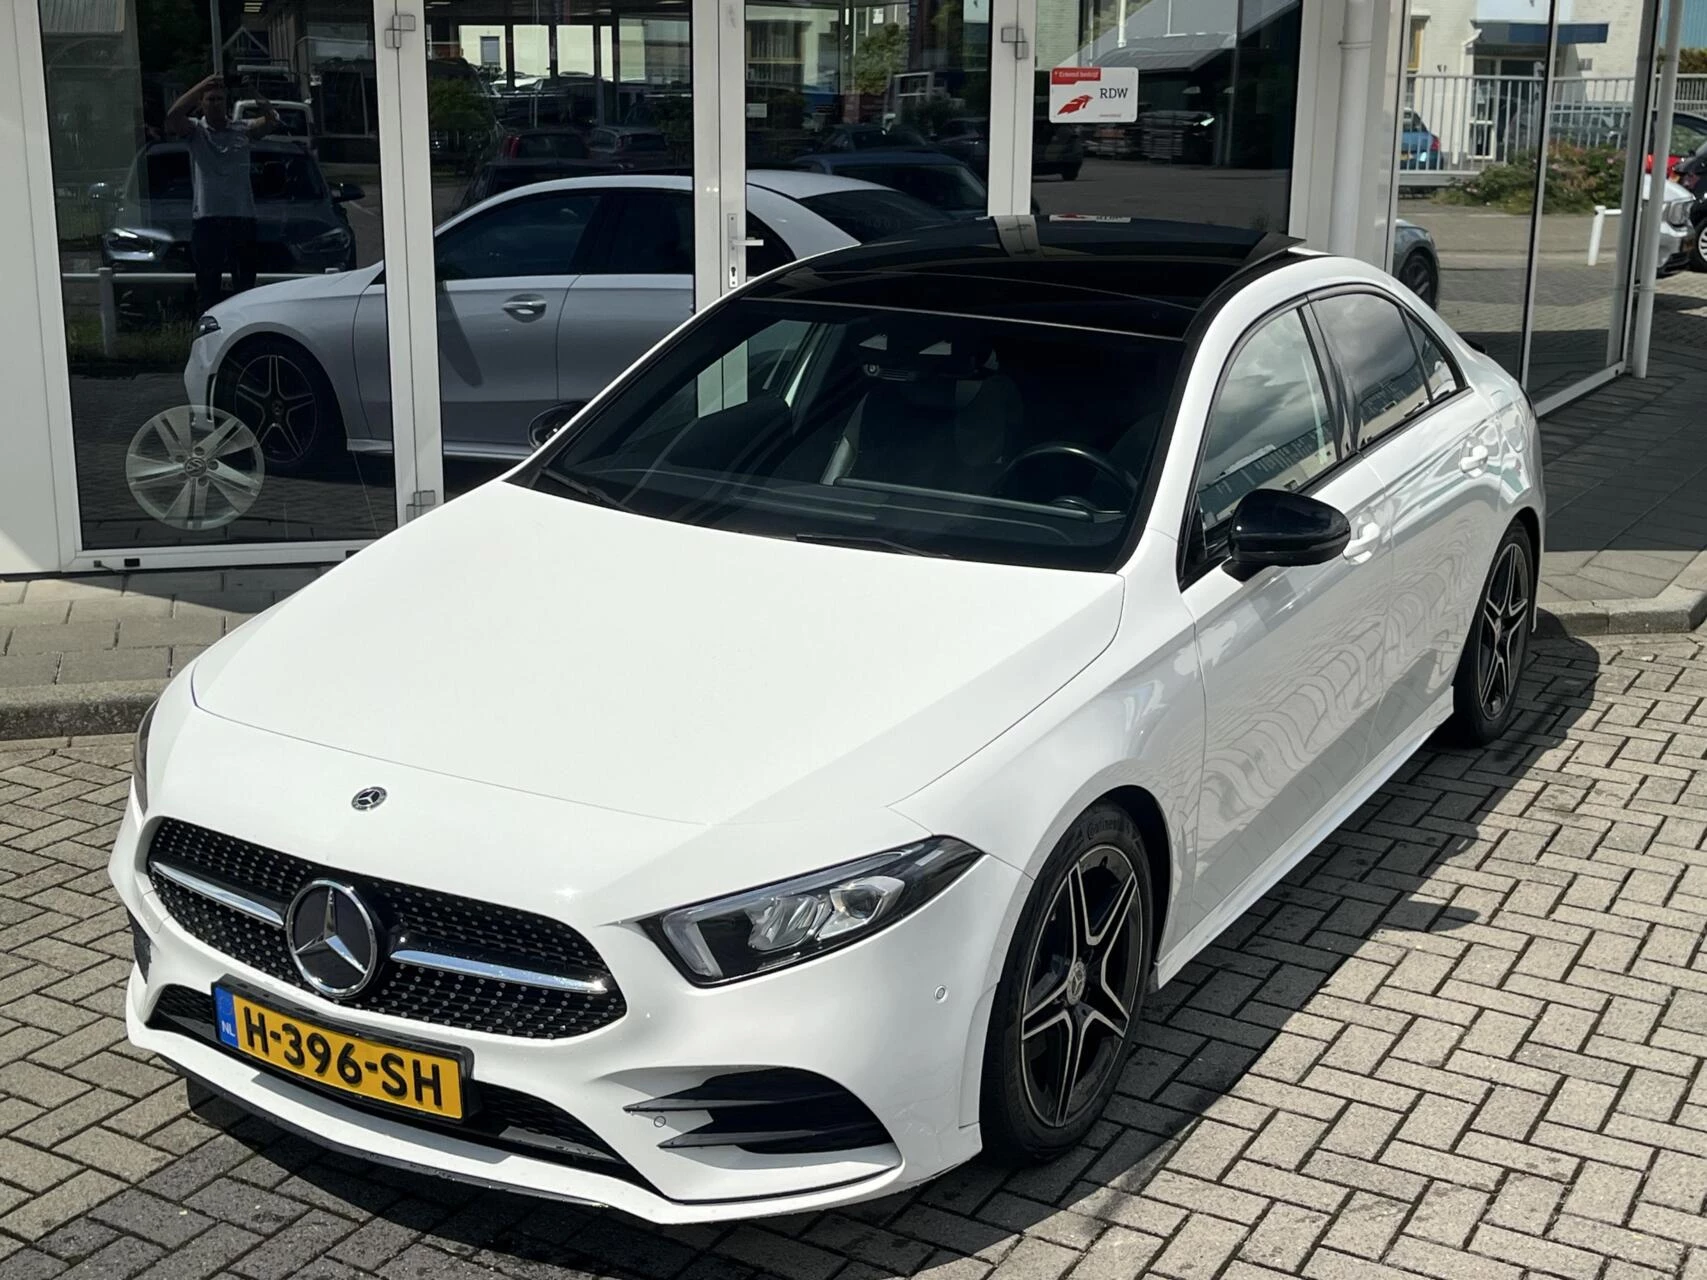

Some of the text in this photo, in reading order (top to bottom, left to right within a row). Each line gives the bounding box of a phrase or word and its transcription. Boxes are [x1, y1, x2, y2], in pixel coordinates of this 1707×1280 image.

[1100, 87, 1128, 99] RDW
[221, 1020, 236, 1038] NL
[243, 1006, 442, 1107] H-396-SH
